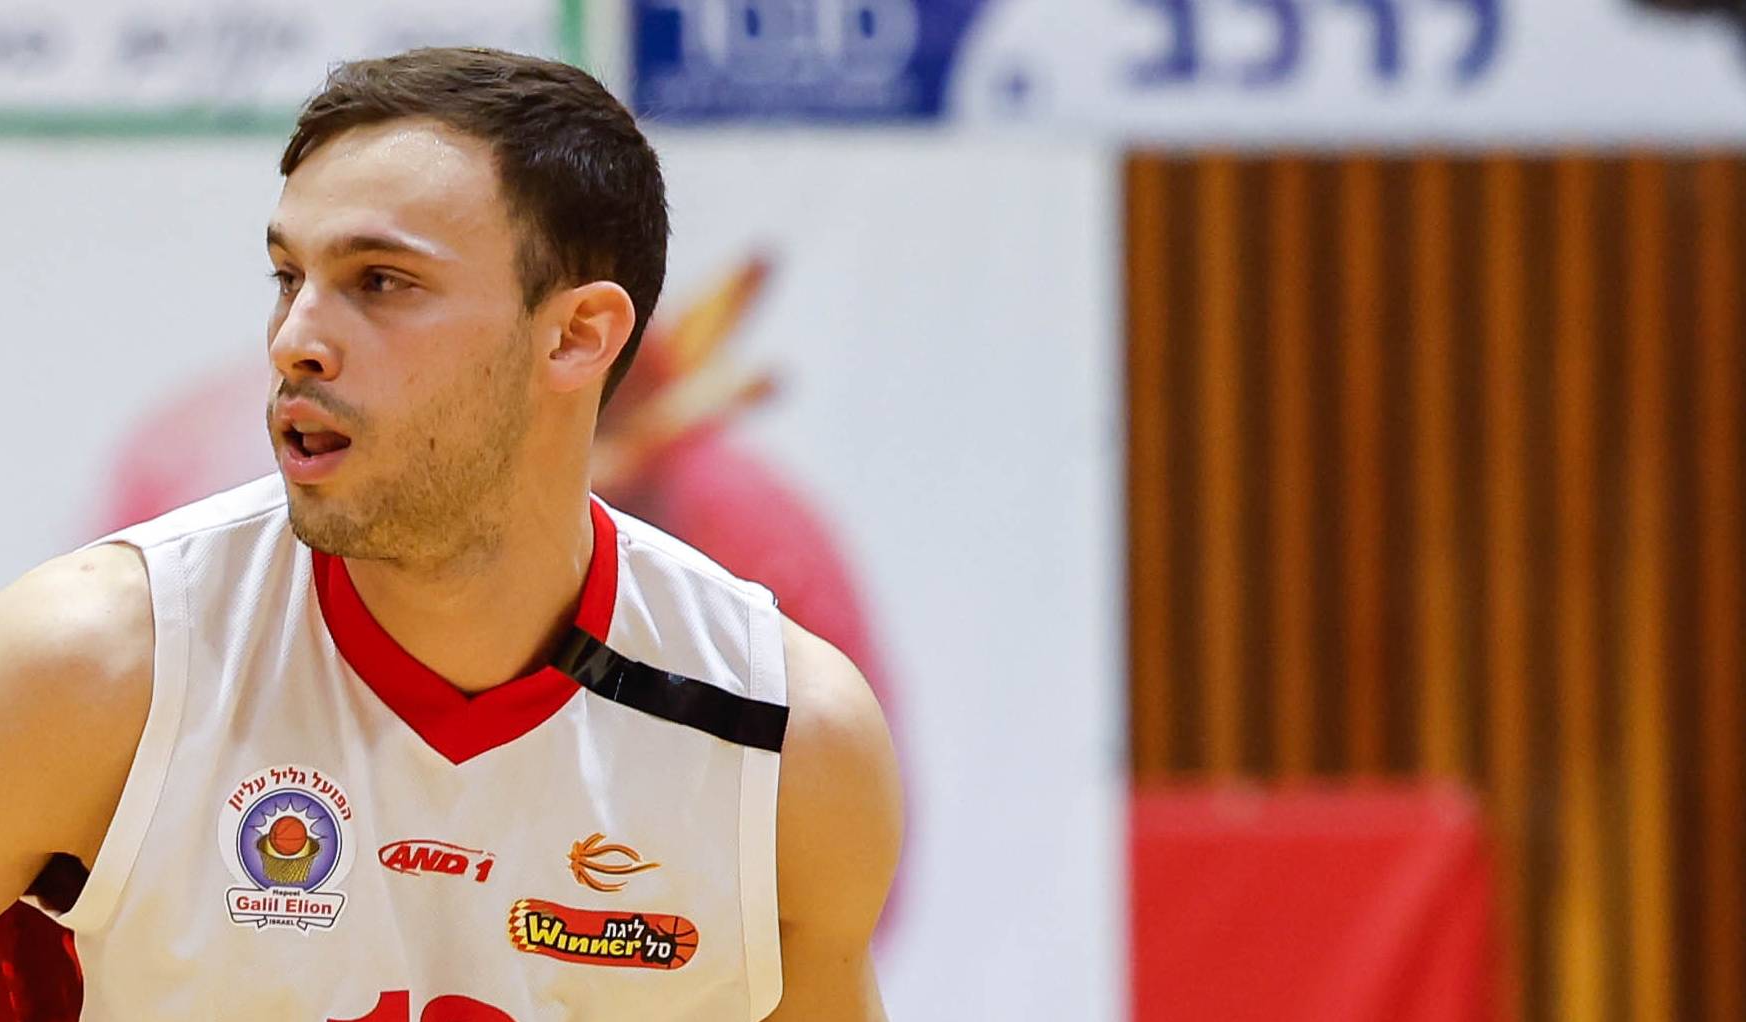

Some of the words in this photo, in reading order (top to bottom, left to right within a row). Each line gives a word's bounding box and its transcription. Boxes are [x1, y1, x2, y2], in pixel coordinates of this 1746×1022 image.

[269, 766, 307, 785] גליל
[227, 775, 267, 813] עליון
[311, 771, 353, 821] הפועל
[384, 845, 469, 875] AND
[474, 859, 495, 883] 1
[235, 895, 279, 912] Galil
[284, 898, 333, 915] Elion
[268, 917, 295, 927] ISRAEL
[527, 913, 643, 957] Winner
[645, 934, 672, 959] סל
[604, 918, 644, 939] ליגת
